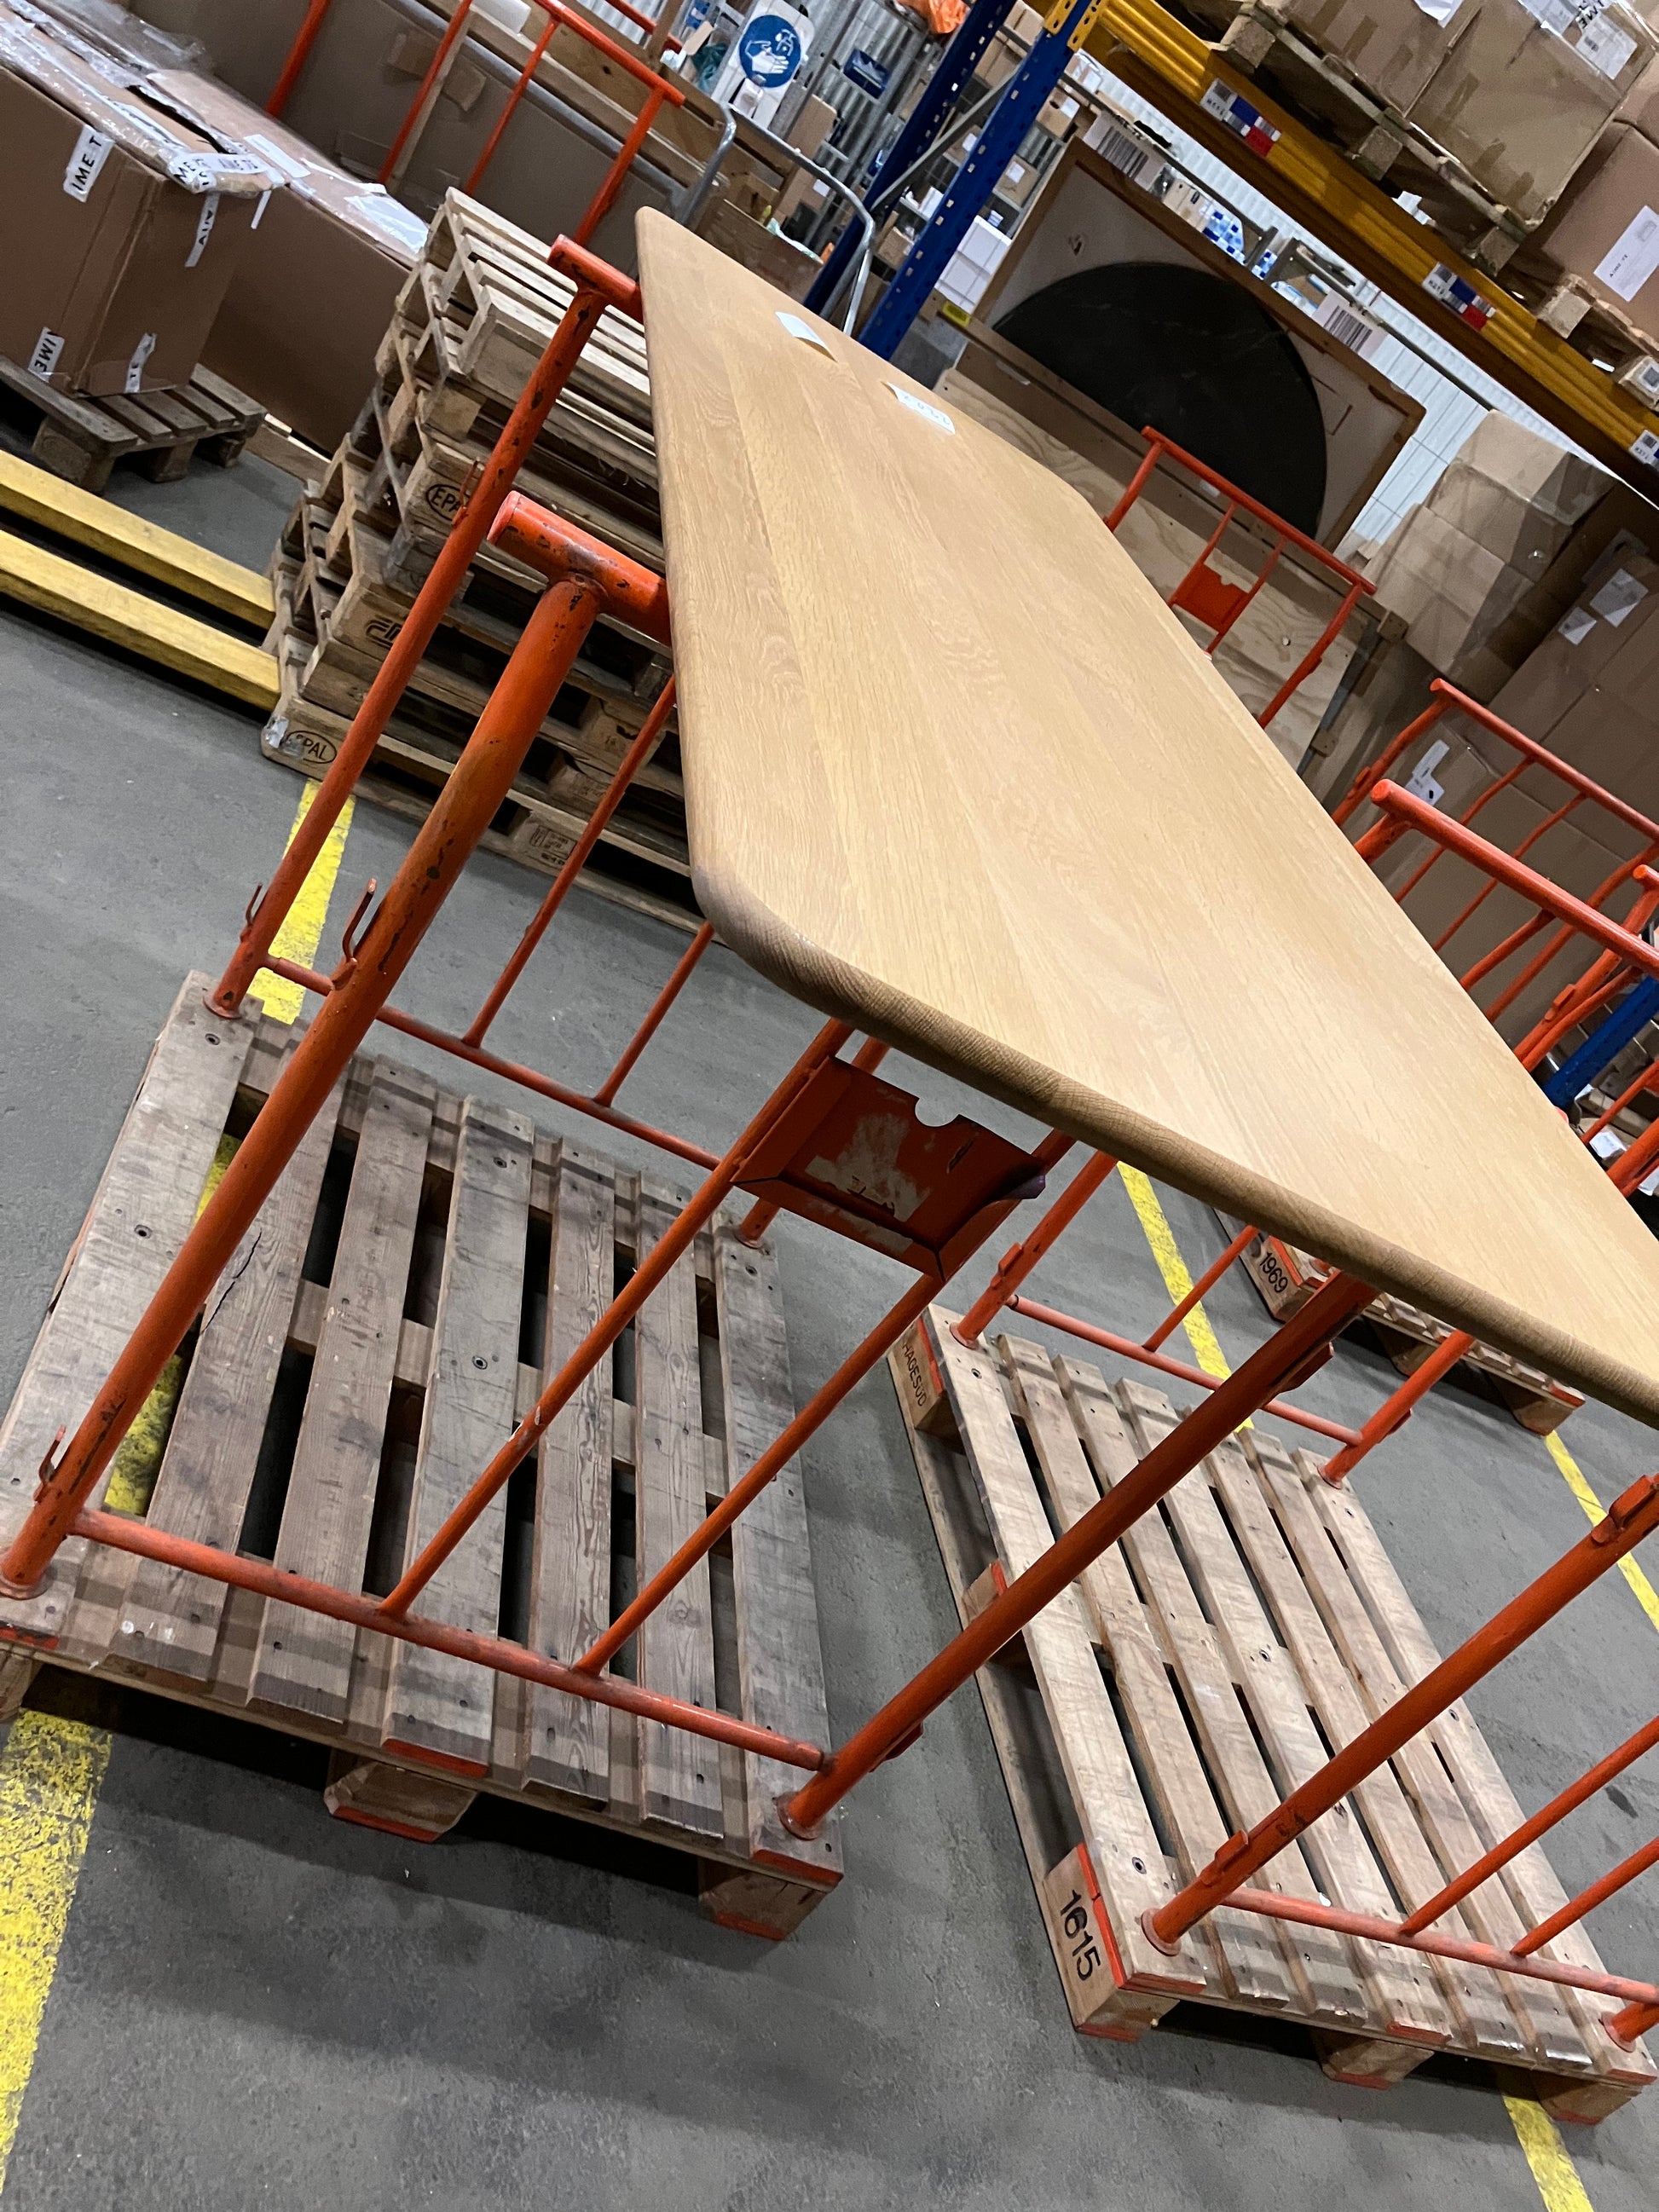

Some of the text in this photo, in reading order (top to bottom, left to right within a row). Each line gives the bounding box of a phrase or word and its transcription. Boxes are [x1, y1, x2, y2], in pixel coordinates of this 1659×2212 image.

[288, 734, 327, 761] PAL
[1259, 1251, 1288, 1293] 1969
[1060, 1889, 1101, 1981] 1615
